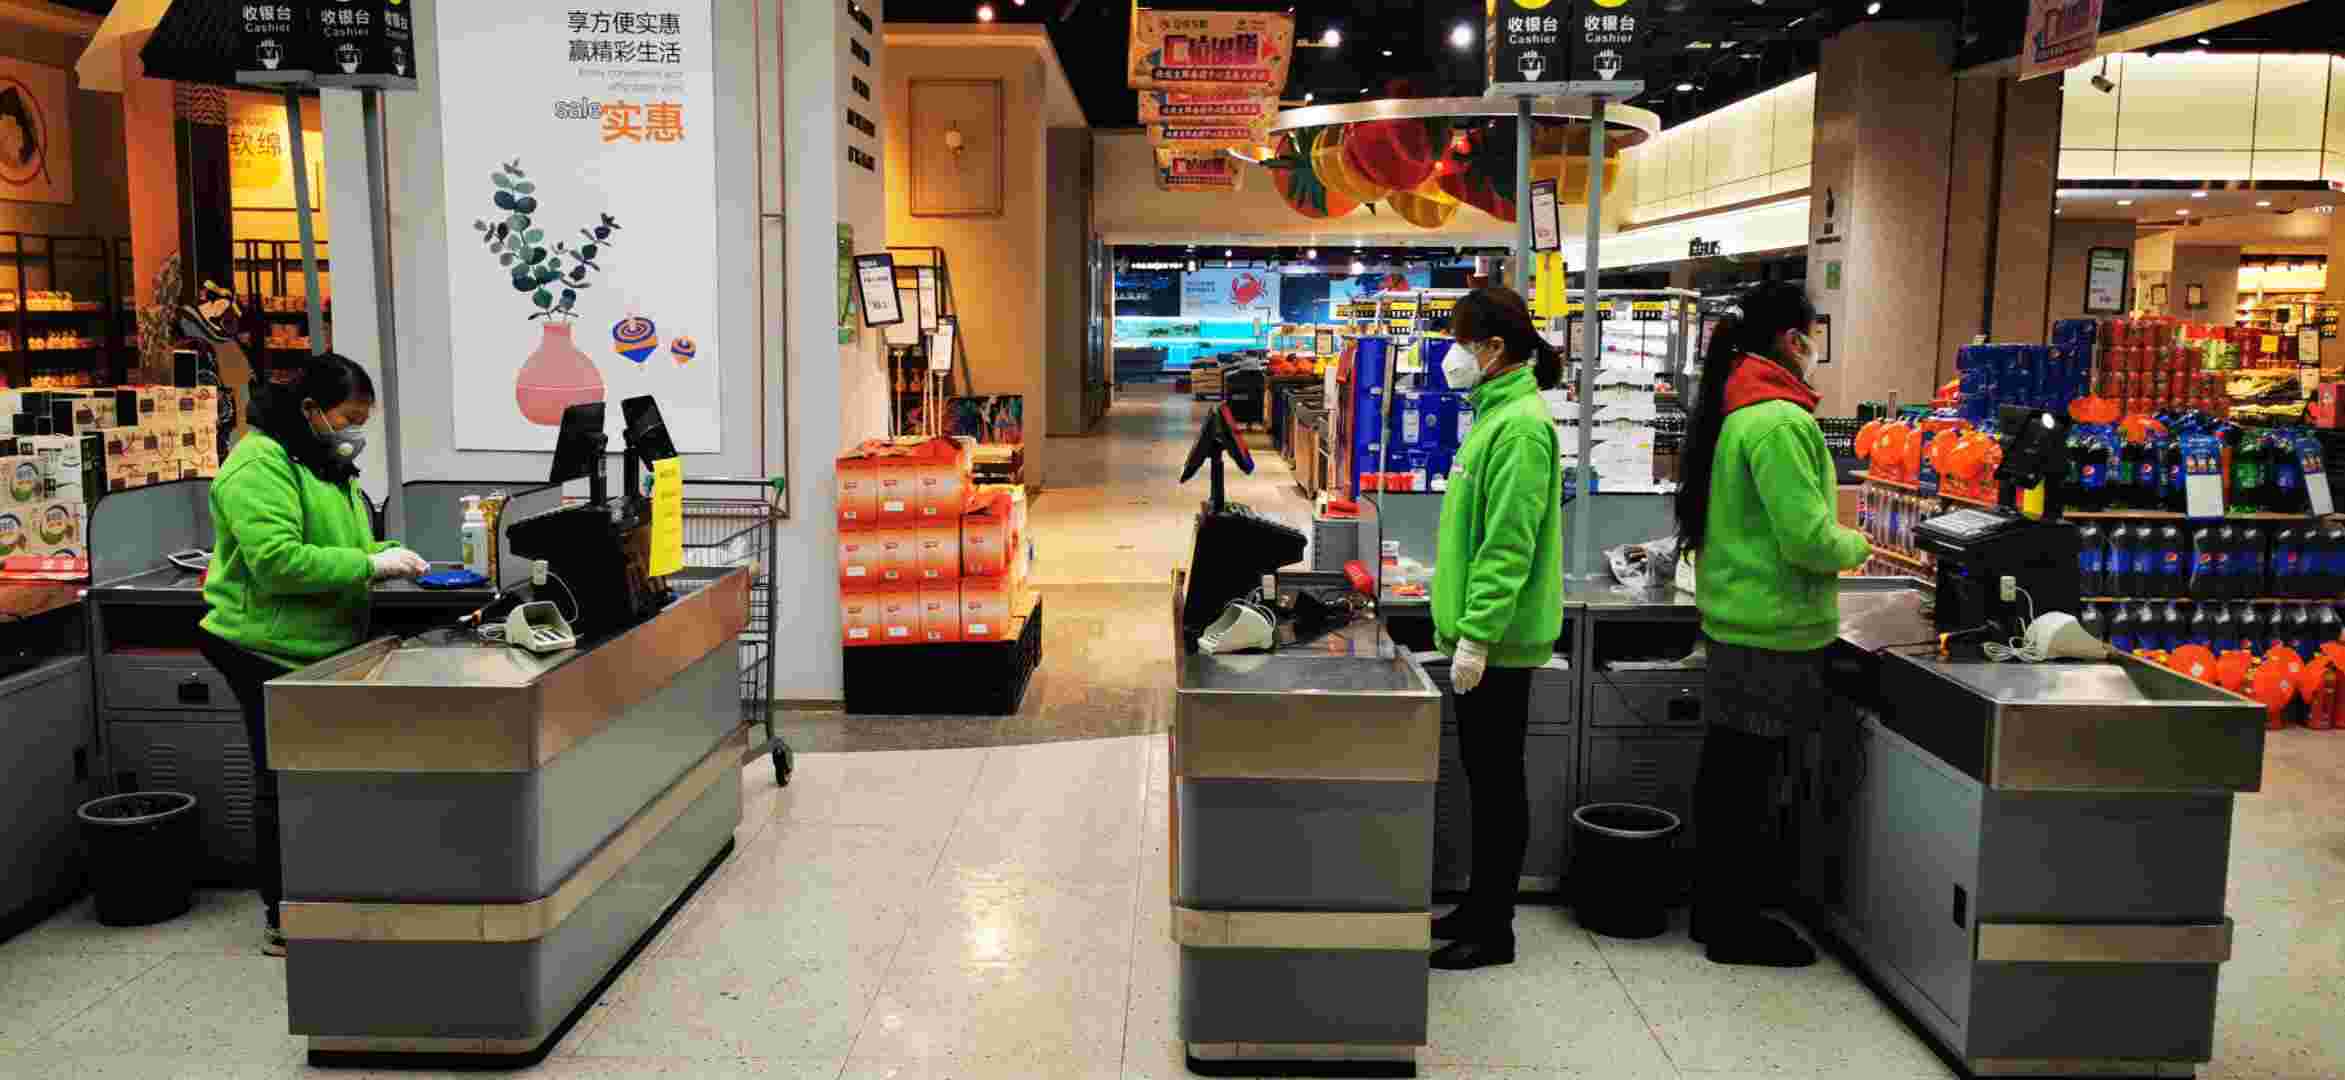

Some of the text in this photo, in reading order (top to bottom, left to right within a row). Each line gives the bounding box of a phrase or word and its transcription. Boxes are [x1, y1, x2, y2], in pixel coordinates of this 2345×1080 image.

[242, 5, 291, 21] 收银台
[321, 9, 370, 25] 收银台
[245, 23, 290, 33] Cashier
[567, 10, 681, 34] 享方便实惠
[1507, 16, 1558, 32] 收银台
[1584, 15, 1635, 31] 收银台
[1509, 34, 1556, 45] Cashier
[1585, 33, 1633, 43] Cashier
[567, 39, 681, 63] 赢精彩生活
[553, 96, 685, 142] sale 实惠
